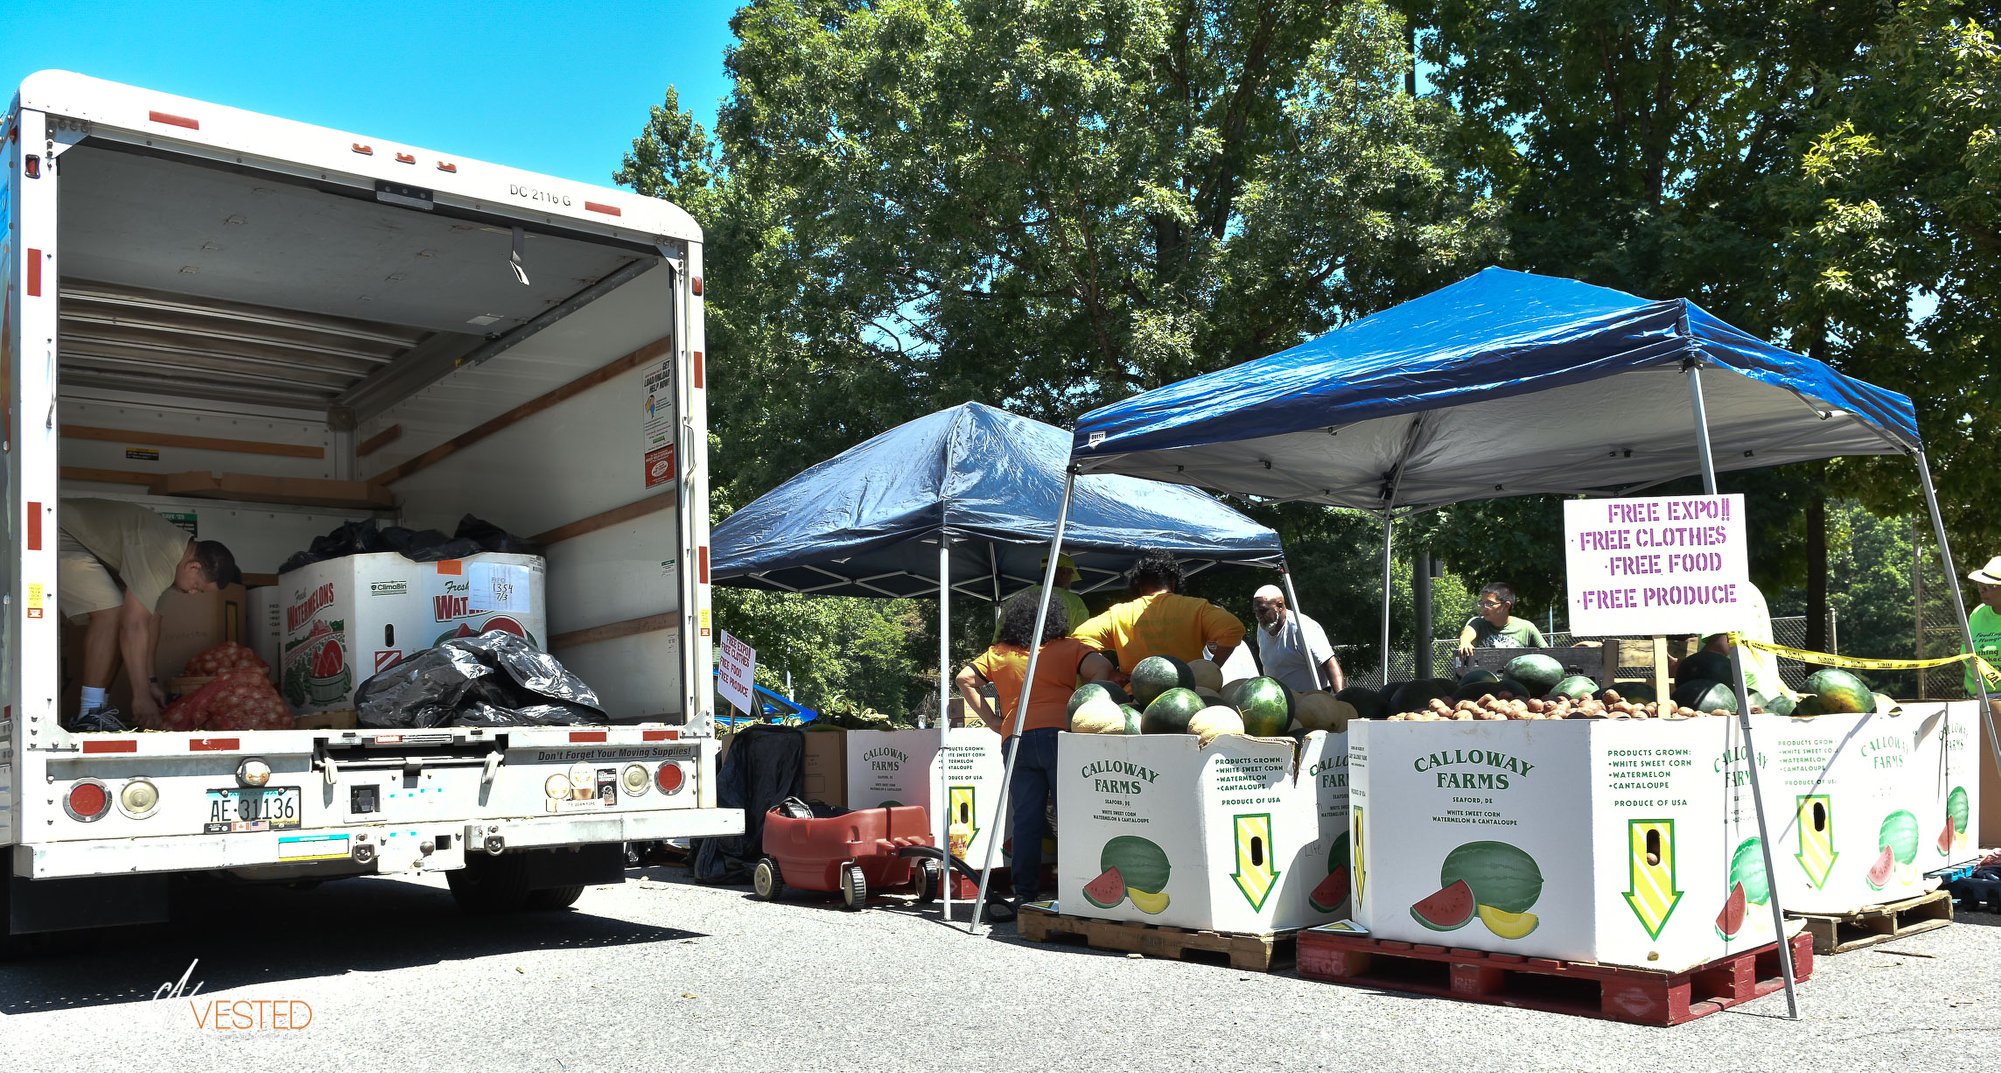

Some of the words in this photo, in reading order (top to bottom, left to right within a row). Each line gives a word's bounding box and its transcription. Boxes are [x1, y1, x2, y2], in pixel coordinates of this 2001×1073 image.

[510, 184, 528, 198] DC
[532, 189, 559, 204] 2116
[562, 195, 571, 206] G
[1608, 502, 1660, 523] FREE
[1667, 498, 1730, 521] EXPO!!
[1580, 529, 1631, 551] FREE
[1636, 526, 1727, 547] CLOTHES
[1610, 554, 1662, 576] FREE
[1668, 552, 1722, 573] FOOD
[1582, 588, 1637, 610] FREE
[1643, 584, 1737, 607] PRODUCE
[538, 751, 563, 761] Don't
[566, 750, 595, 760] Forget
[597, 749, 616, 758] Your
[618, 748, 650, 758] Moving
[652, 747, 692, 757] Supplies!
[863, 747, 909, 763] CALLOWAY
[1215, 757, 1251, 765] PRODUCTS
[1607, 749, 1652, 757] PRODUCTS
[871, 761, 900, 771] FARMS
[1413, 749, 1536, 777] CALLOWAY
[1612, 760, 1638, 768] WHITE
[1081, 760, 1160, 784] CALLOWAY
[1094, 779, 1142, 795] FARMS
[1436, 772, 1510, 790] FARMS
[1452, 796, 1483, 804] SEAFORD,
[1478, 818, 1518, 826] CANTALOUPE
